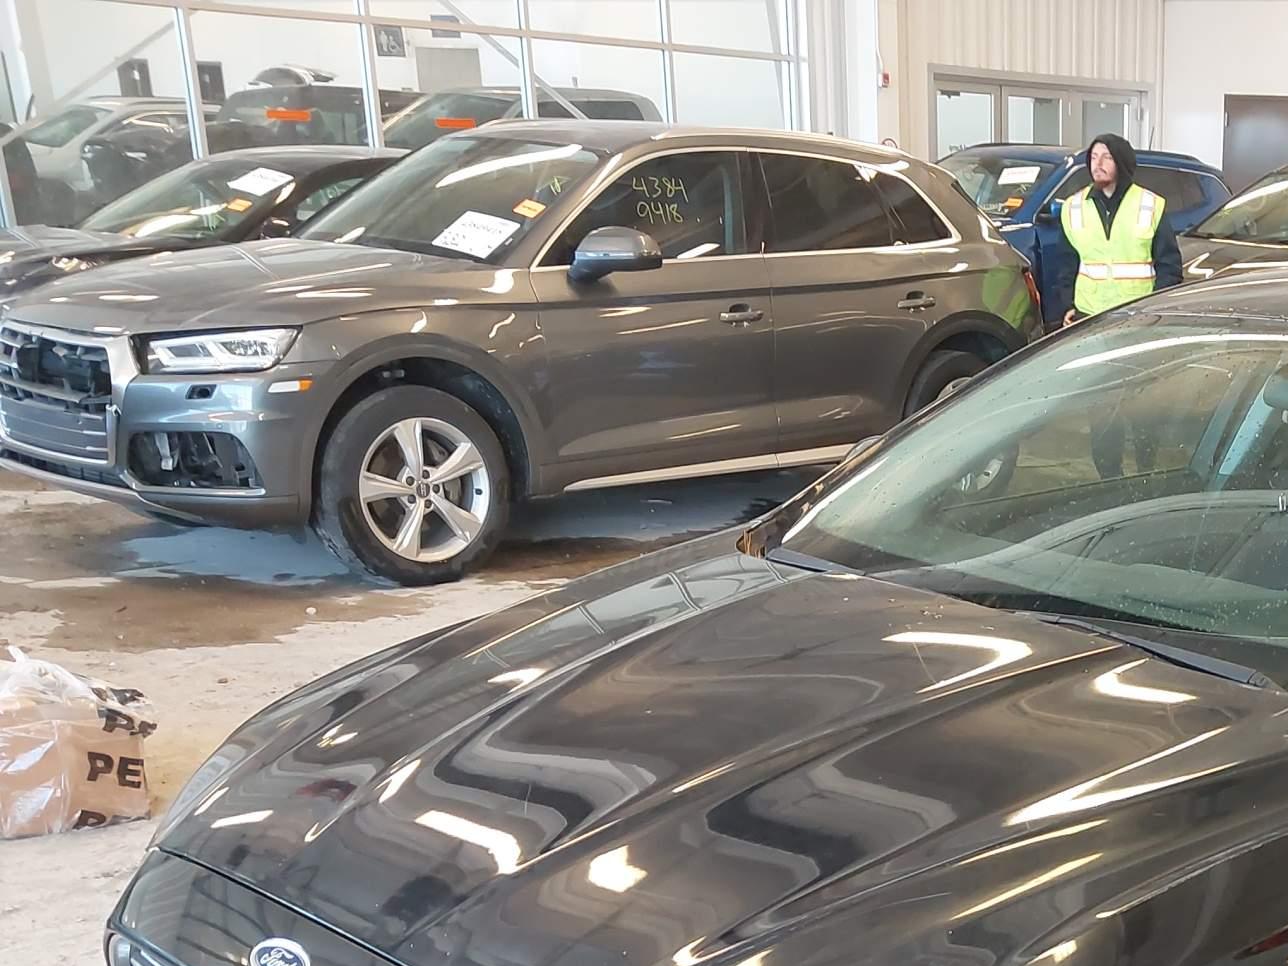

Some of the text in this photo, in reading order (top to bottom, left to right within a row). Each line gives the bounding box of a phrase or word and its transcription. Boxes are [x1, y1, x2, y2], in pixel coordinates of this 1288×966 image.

[632, 176, 689, 203] 4384
[636, 201, 683, 225] 9418
[87, 751, 145, 789] PE
